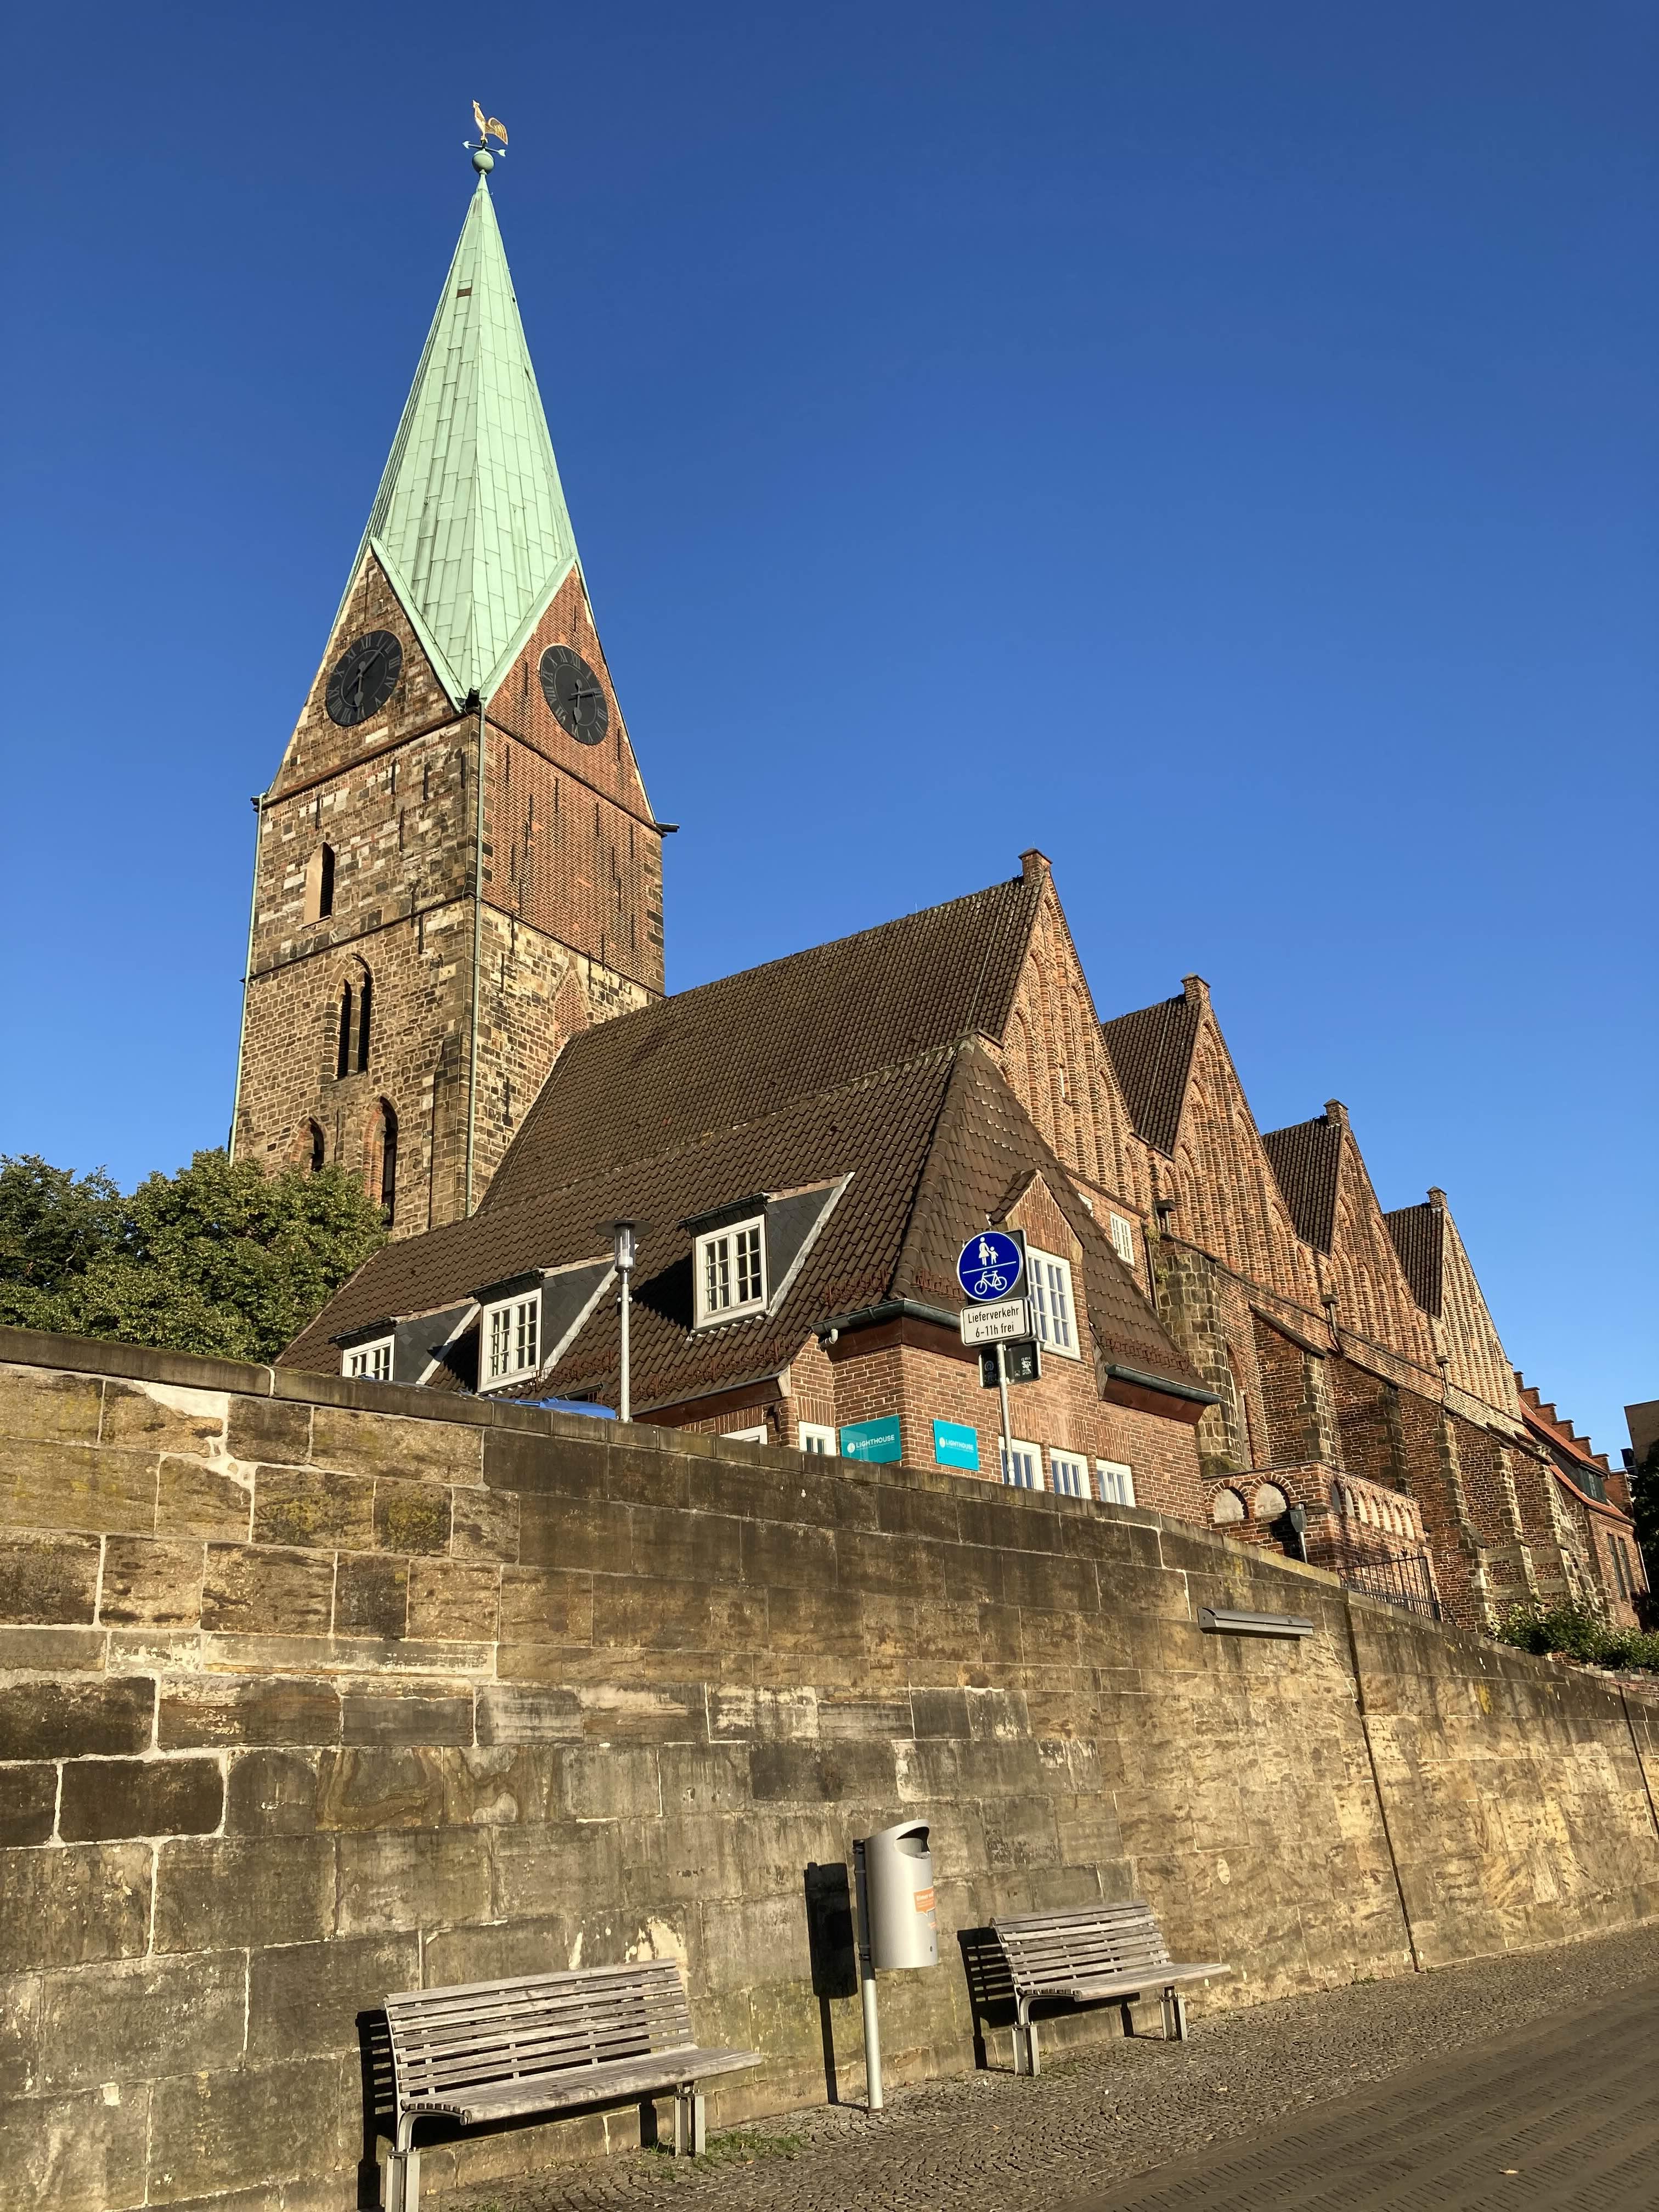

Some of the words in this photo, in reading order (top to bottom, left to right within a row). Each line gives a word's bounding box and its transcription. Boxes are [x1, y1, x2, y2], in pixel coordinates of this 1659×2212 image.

[360, 634, 372, 652] XII
[388, 655, 400, 670] III
[557, 648, 568, 663] XI
[571, 651, 580, 670] XII
[968, 1306, 1019, 1324] Lieferverkehr
[975, 1324, 998, 1338] 6-11h
[1001, 1321, 1014, 1334] frei
[856, 1434, 895, 1448] LIGHTHOUSE
[945, 1439, 974, 1451] LIGHTHOUSE
